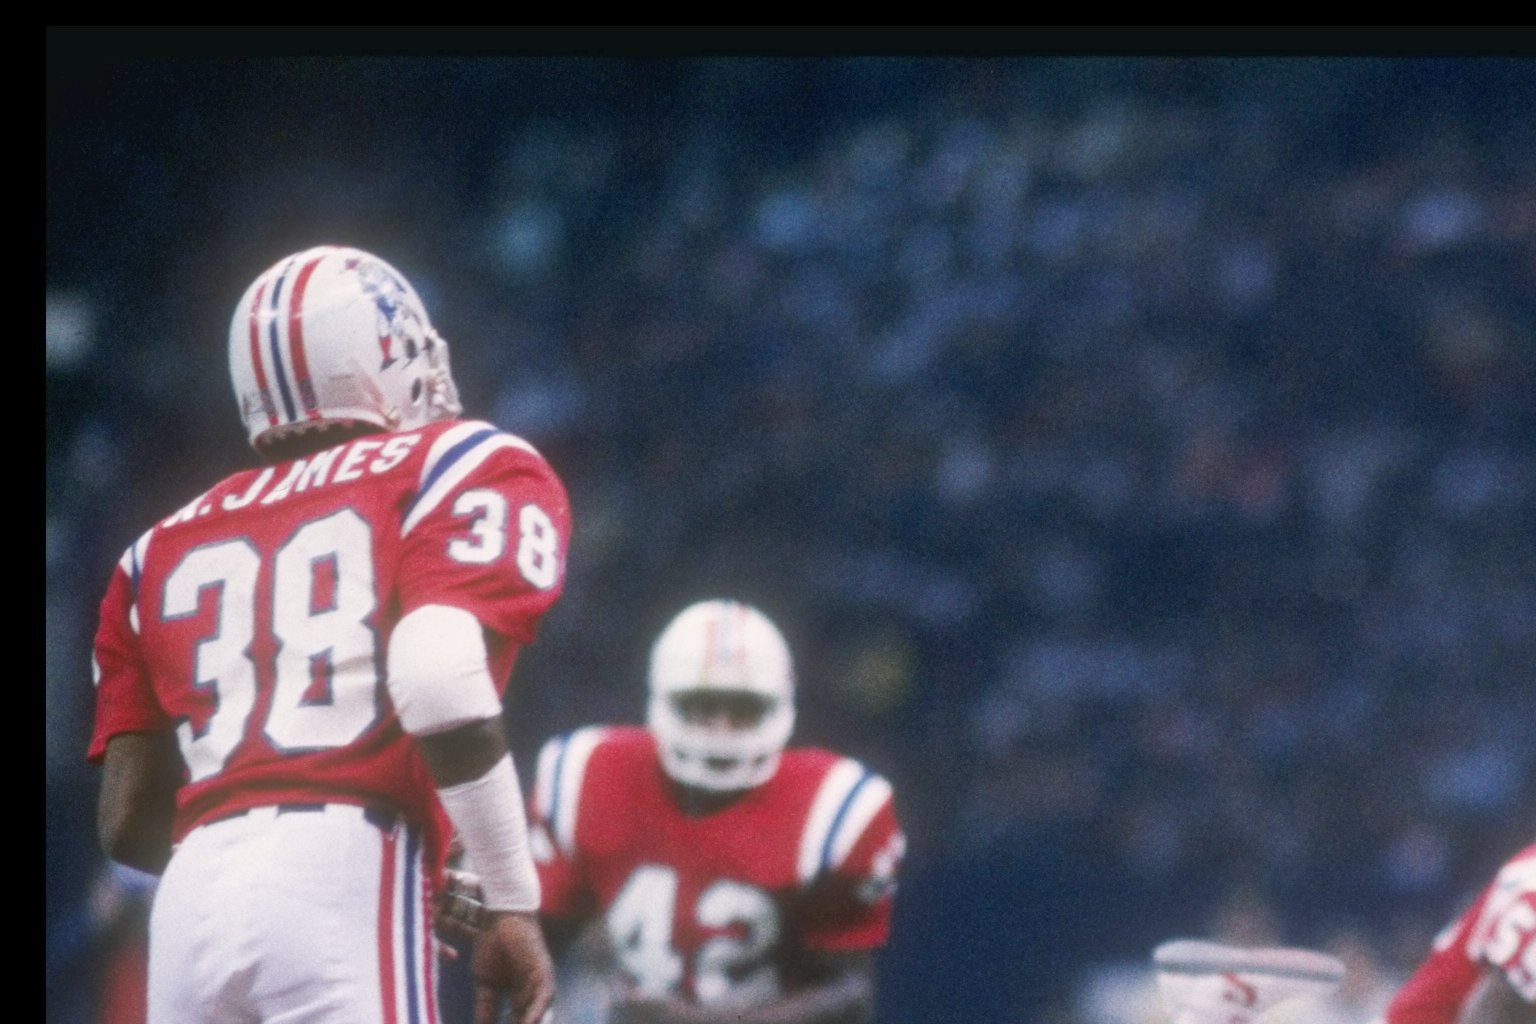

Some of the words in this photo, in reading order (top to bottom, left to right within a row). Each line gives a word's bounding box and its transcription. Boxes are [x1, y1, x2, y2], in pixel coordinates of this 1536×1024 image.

[447, 487, 561, 590] 38
[159, 505, 381, 785] 38
[605, 861, 788, 1010] 42
